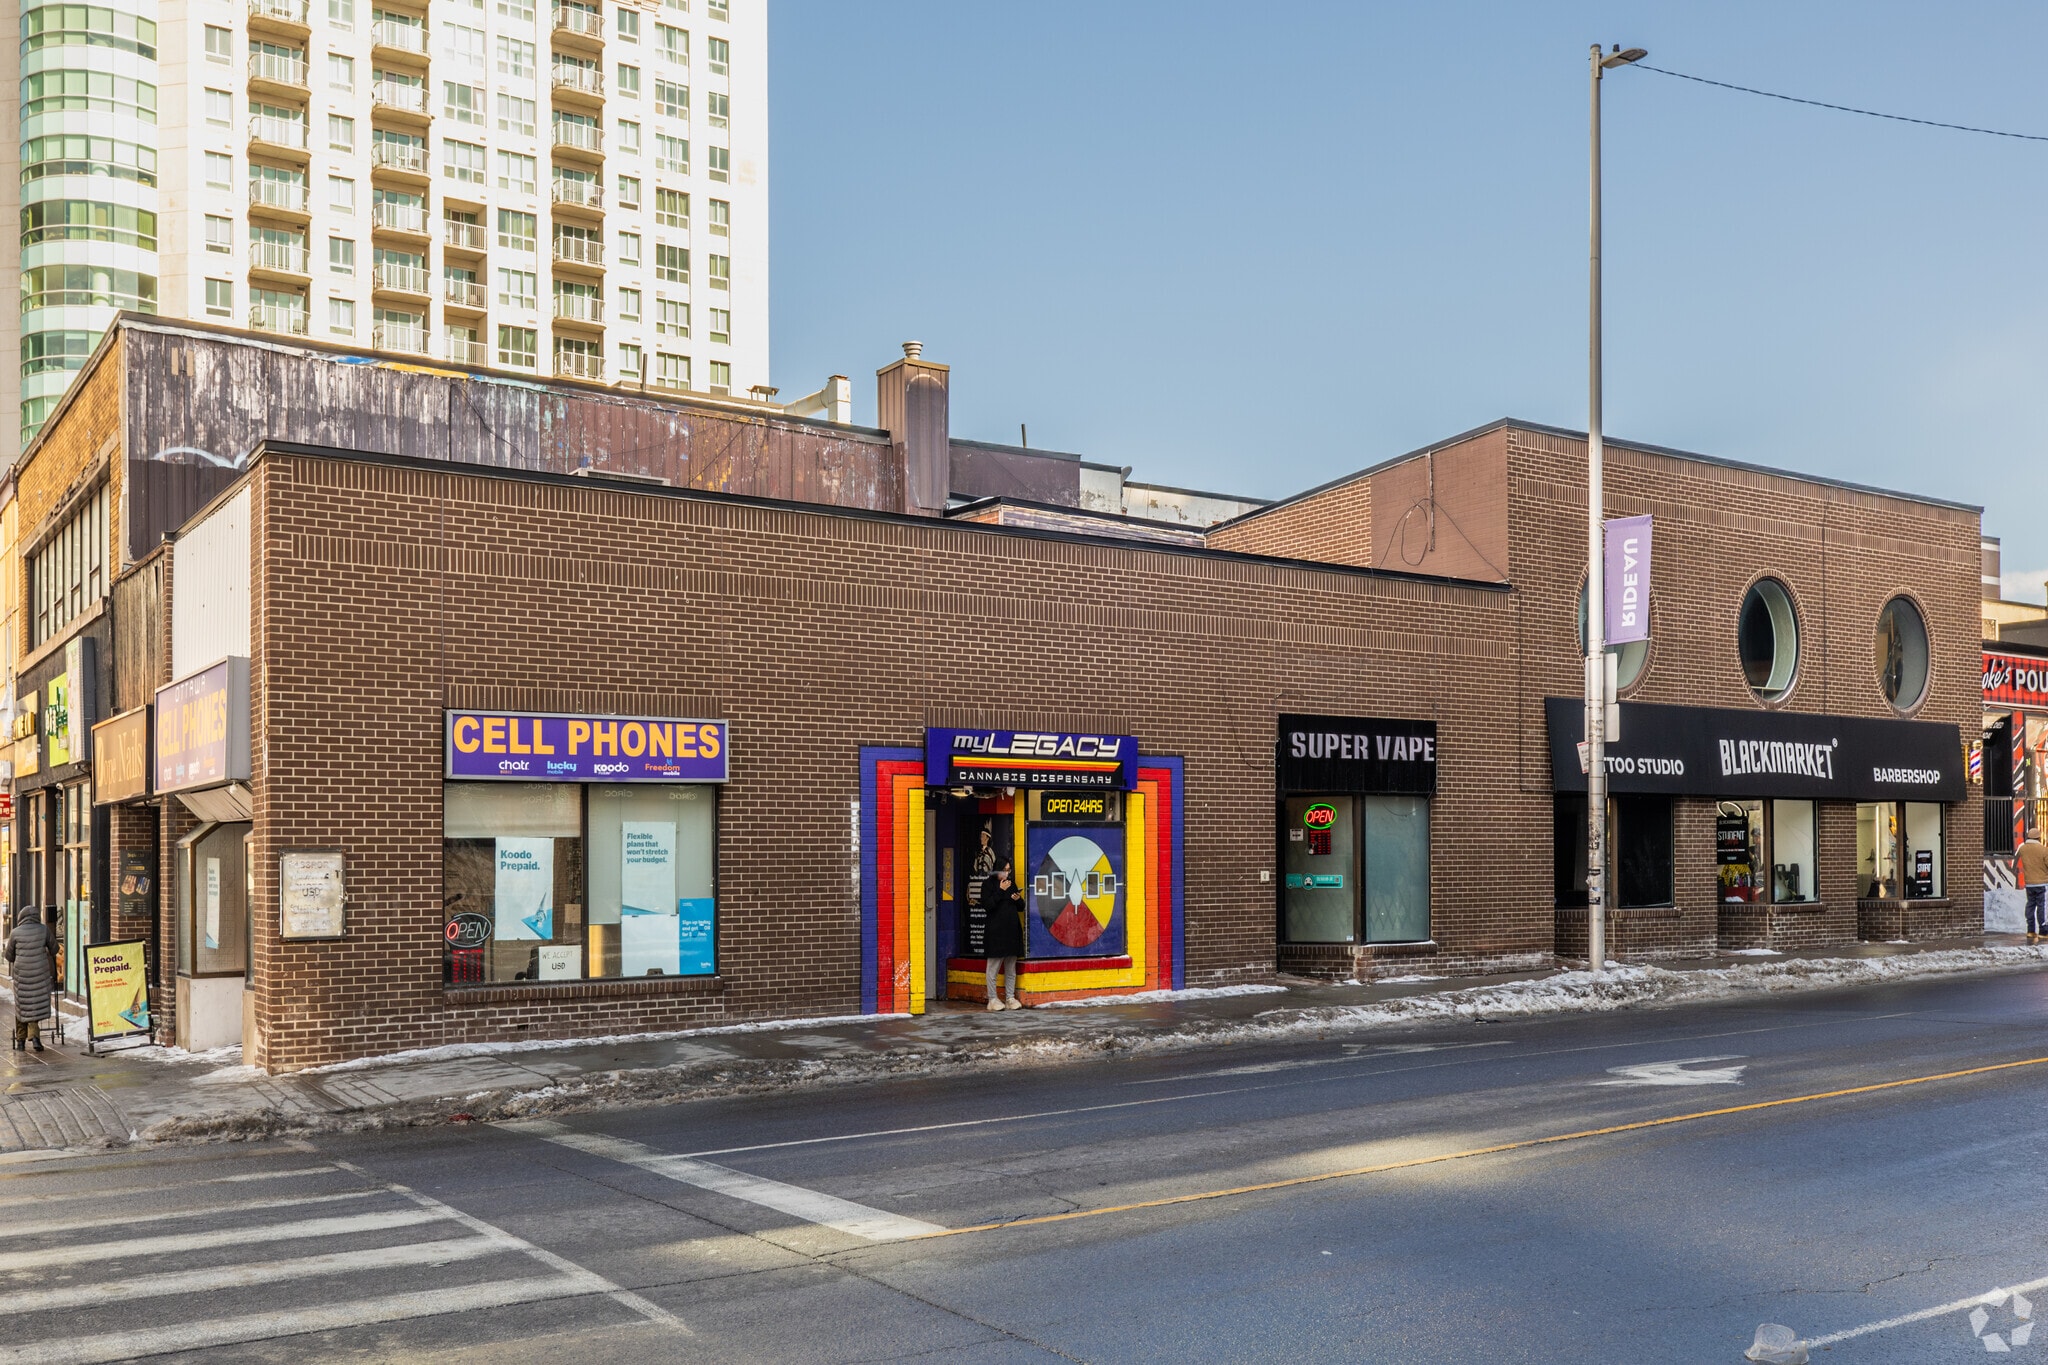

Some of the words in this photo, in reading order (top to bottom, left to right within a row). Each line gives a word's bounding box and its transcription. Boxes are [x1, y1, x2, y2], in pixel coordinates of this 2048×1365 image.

[175, 675, 206, 702] OTTAWA
[182, 688, 226, 752] PHONES
[453, 716, 555, 755] CELL
[568, 720, 721, 759] PHONES
[1292, 732, 1369, 760] SUPER
[1376, 735, 1435, 761] VAPE
[96, 736, 117, 794] Dope
[118, 728, 143, 782] Nails
[498, 760, 530, 771] chatr
[547, 761, 577, 772] lucky
[645, 763, 681, 771] Freedom
[1603, 757, 1635, 774] TOO
[1637, 757, 1684, 776] STUDIO
[594, 762, 630, 774] koodo
[959, 771, 1027, 781] CANNABIS
[1032, 774, 1112, 784] DISPENSARY
[1873, 767, 1941, 784] BARBERSHOP
[1047, 799, 1073, 813] OPEN
[1073, 799, 1104, 813] 24HRS
[1306, 809, 1334, 823] OPEN
[626, 832, 654, 840] Flexible
[1717, 830, 1746, 841] STUDENT
[500, 850, 532, 859] Koodo
[500, 861, 541, 871] Prepaid.
[446, 921, 487, 940] OPEN
[93, 954, 123, 965] Koodo
[542, 951, 551, 959] WE
[552, 950, 573, 959] ACCEPT
[94, 963, 132, 975] Prepaid.
[551, 962, 566, 970] USD
